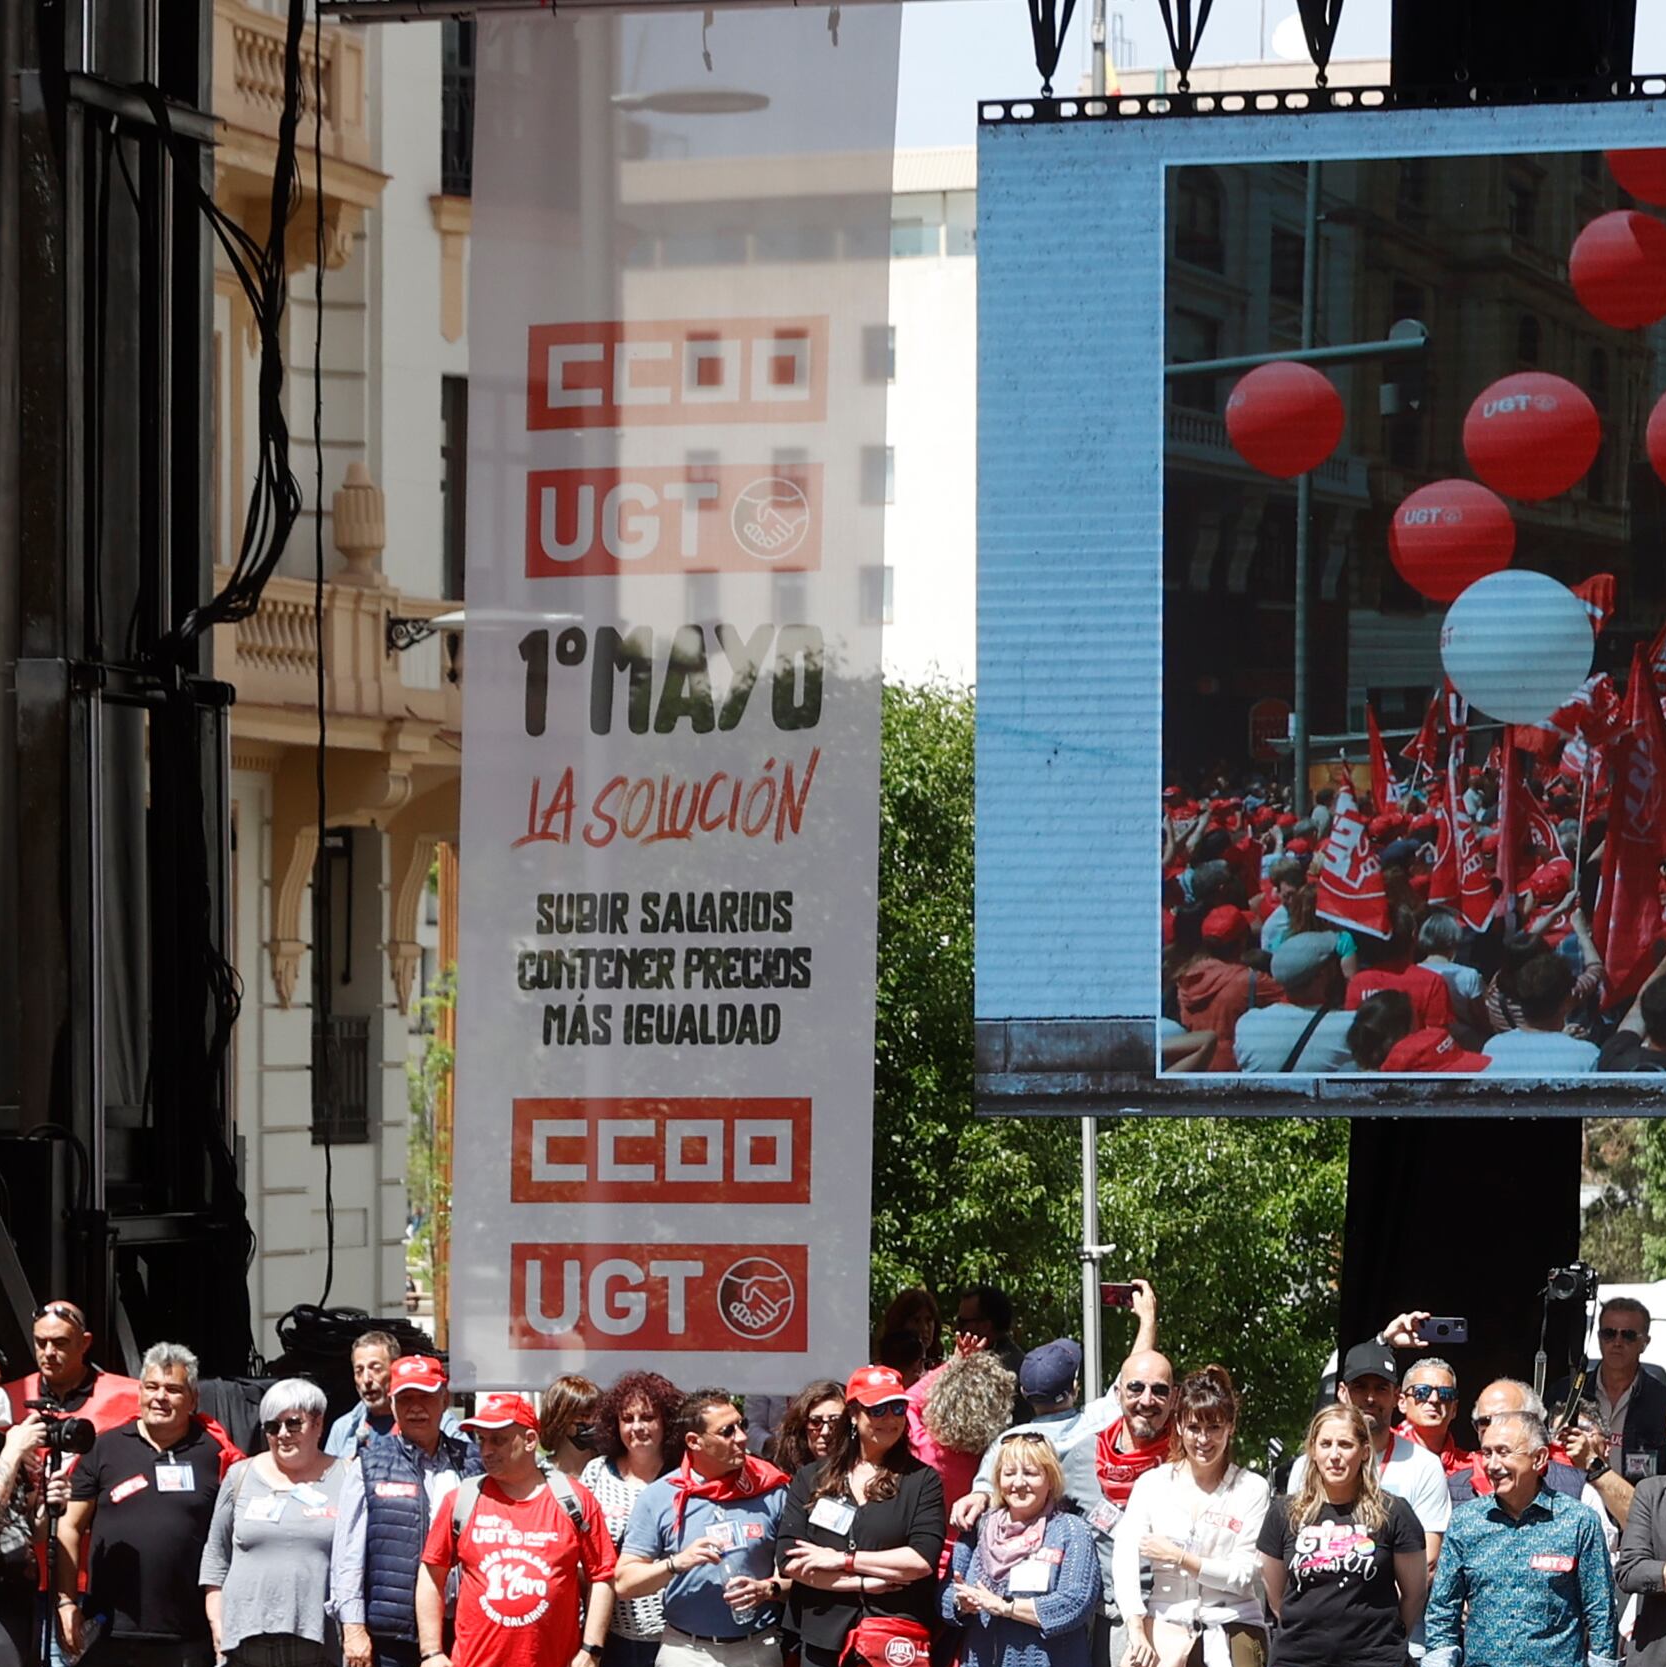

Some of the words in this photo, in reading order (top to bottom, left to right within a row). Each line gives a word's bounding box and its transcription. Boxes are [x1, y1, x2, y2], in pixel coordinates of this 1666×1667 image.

[547, 337, 811, 409] CCOO
[1483, 394, 1532, 419] UGT
[539, 482, 719, 563] UGT
[1404, 507, 1442, 525] UGT
[510, 766, 576, 849] LA
[584, 746, 821, 849] SOLUCIÓN
[536, 893, 629, 934] SUBIR
[641, 890, 793, 934] SALARIOS
[517, 949, 675, 990] CONTENER
[683, 947, 812, 989] PRECIOS
[542, 994, 612, 1046] MÁS
[623, 1003, 781, 1046] IGUALDAD
[530, 1118, 793, 1184] CCOO
[523, 1258, 704, 1337] UGT
[472, 1527, 505, 1544] UGT
[503, 1599, 550, 1628] SALARIOS
[888, 1641, 915, 1657] UGT
